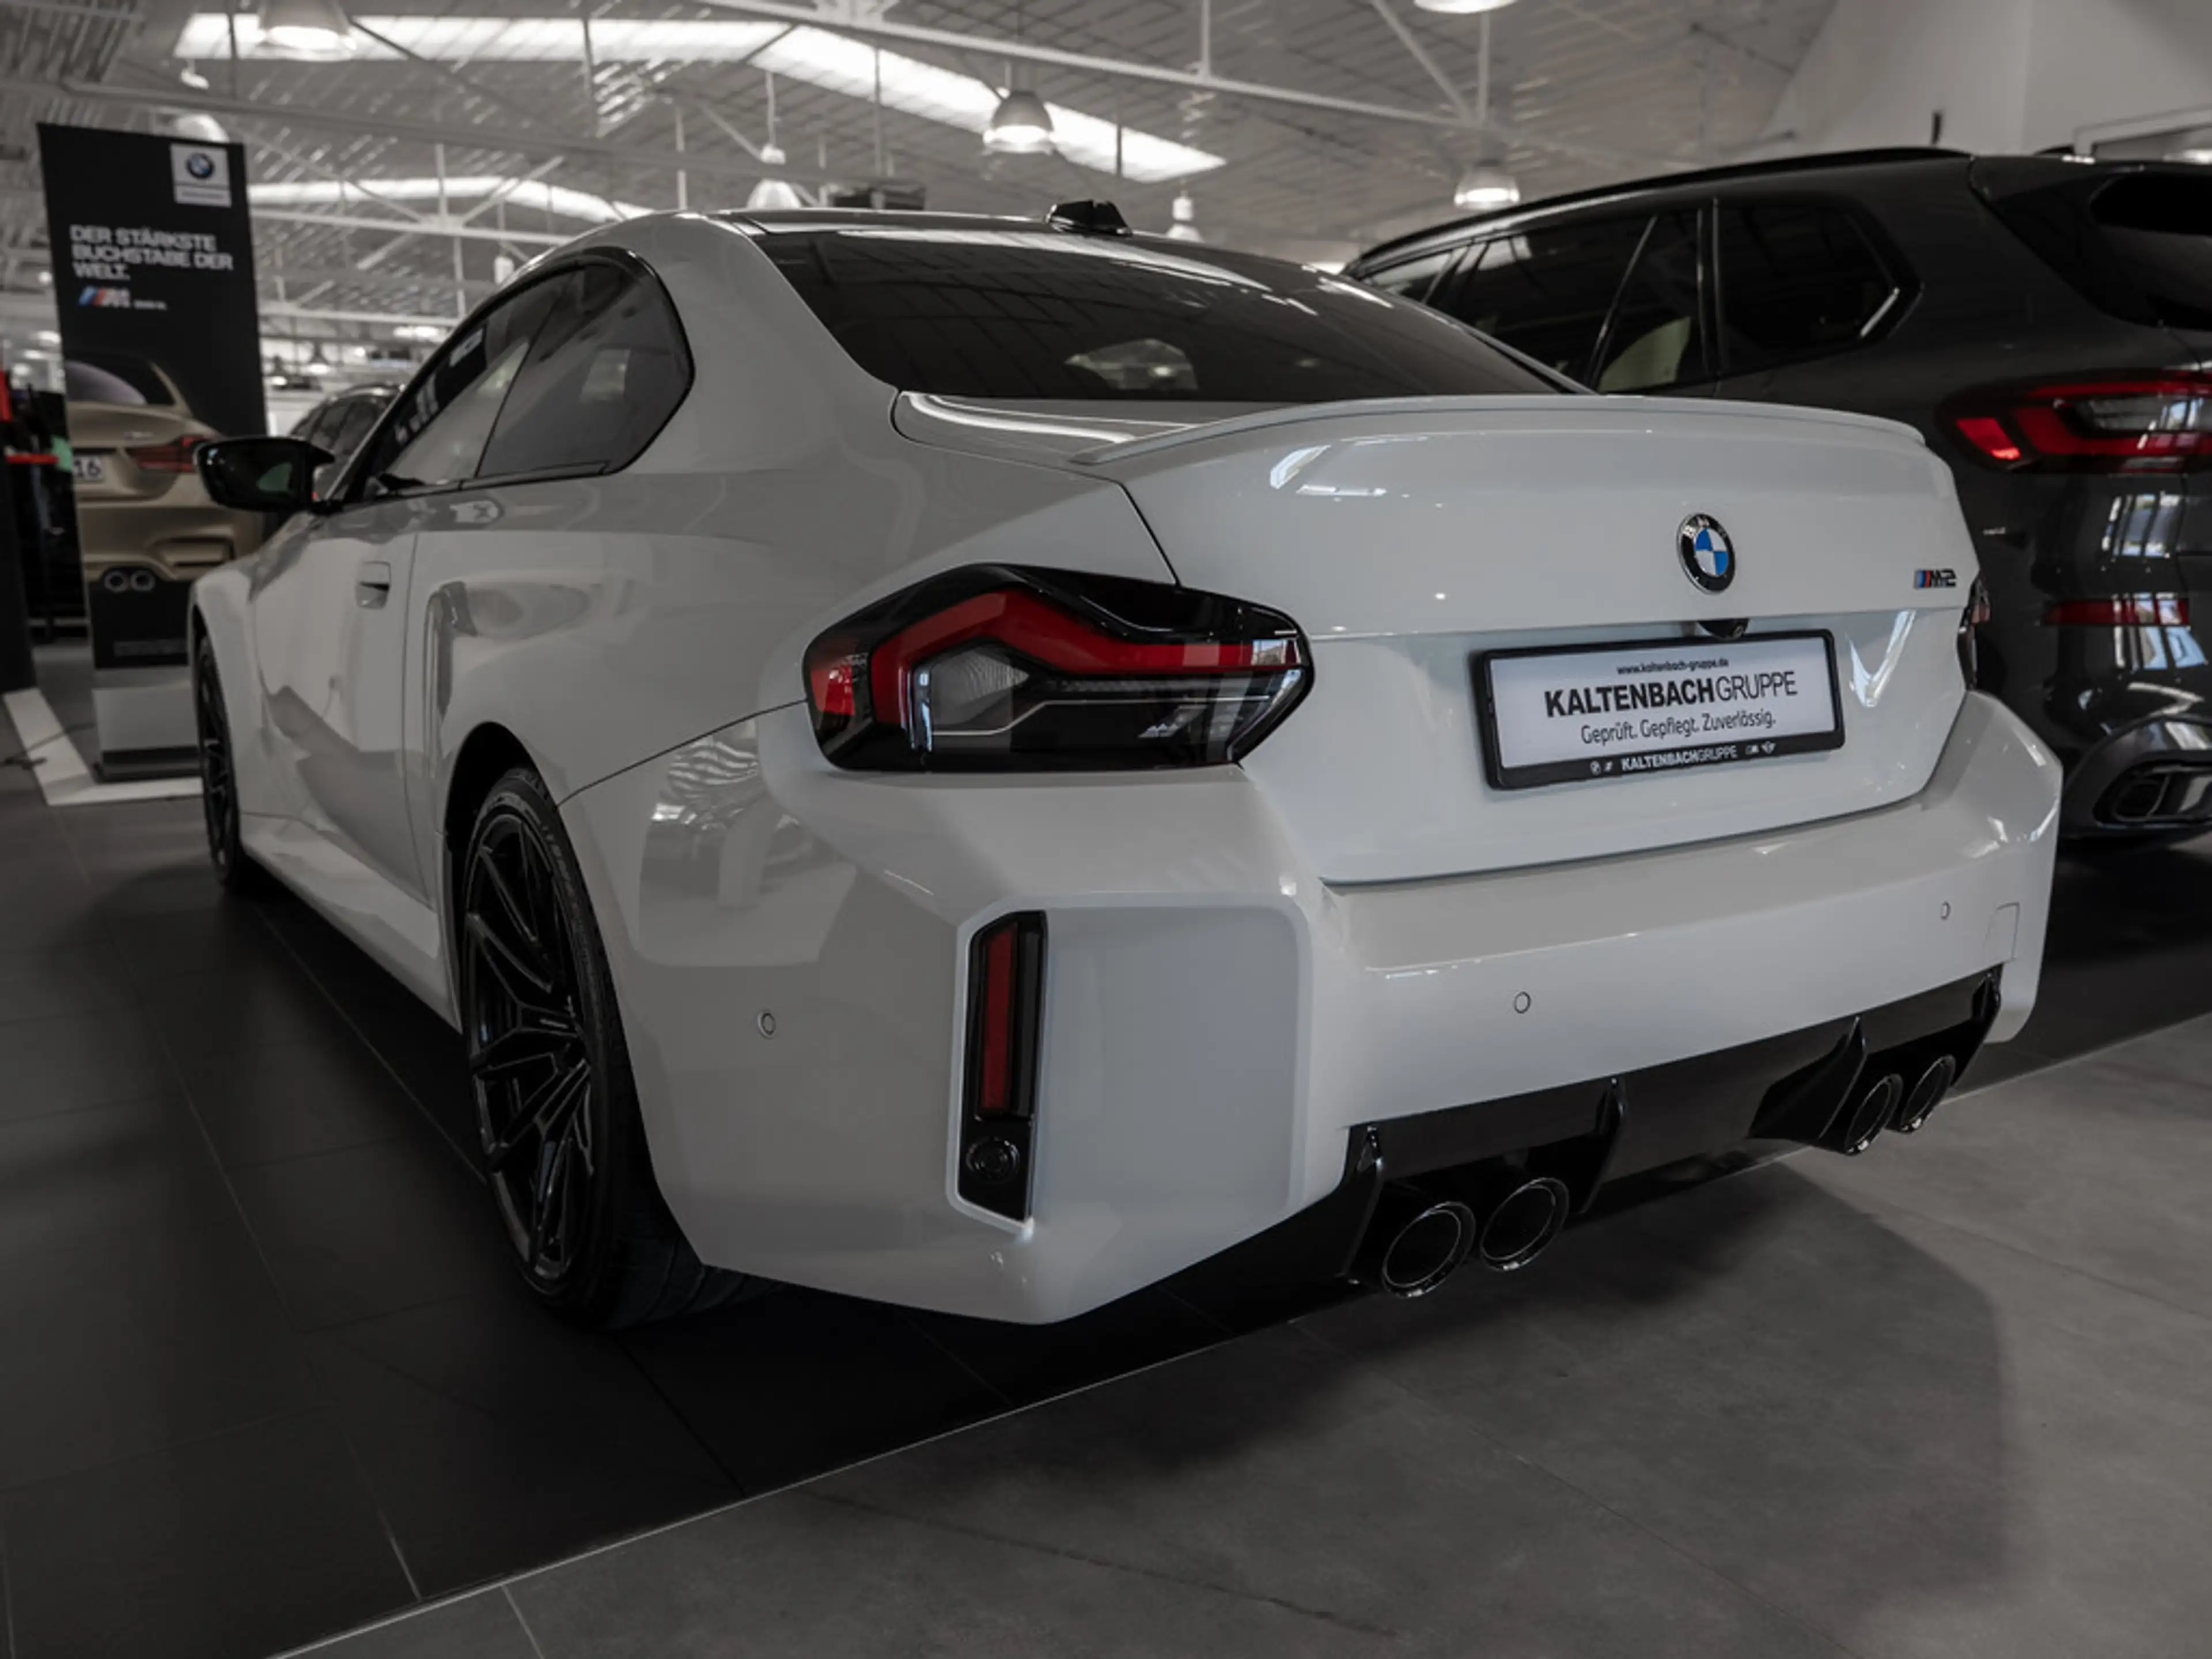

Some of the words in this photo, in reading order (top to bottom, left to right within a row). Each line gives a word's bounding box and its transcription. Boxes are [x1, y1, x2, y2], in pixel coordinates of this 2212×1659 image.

[1581, 721, 1637, 745] Geprüft.
[1640, 717, 1699, 738] Gepflegt.
[1701, 709, 1776, 730] Zuverlässig.
